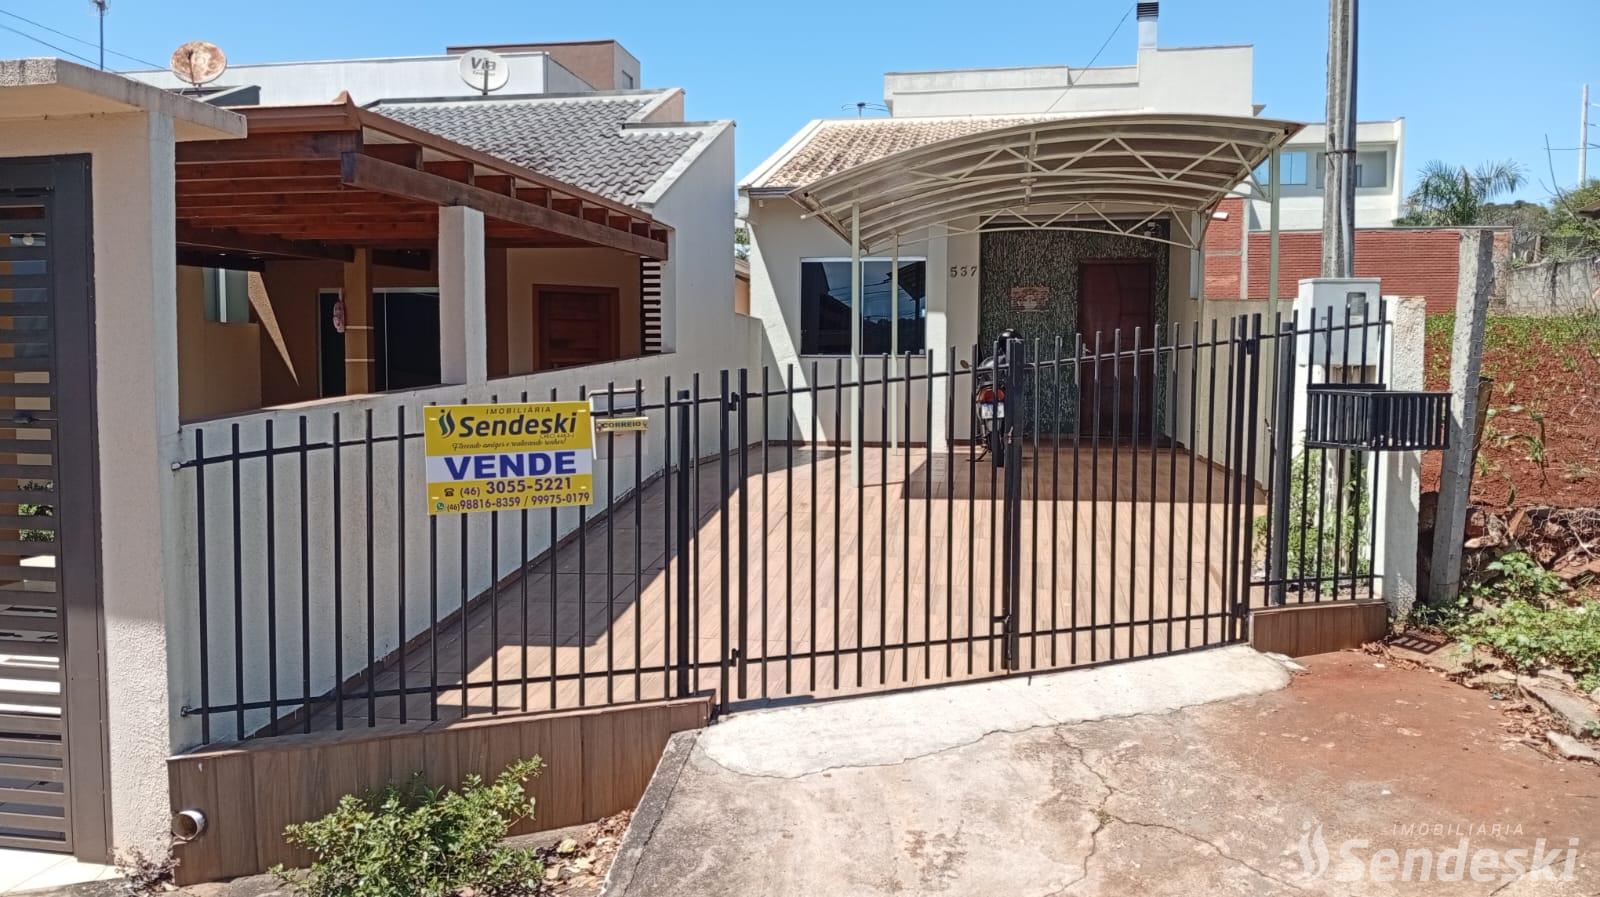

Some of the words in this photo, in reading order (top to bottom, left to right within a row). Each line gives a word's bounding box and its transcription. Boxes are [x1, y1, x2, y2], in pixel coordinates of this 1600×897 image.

[950, 266, 977, 277] 537
[459, 412, 577, 437] Sendeski
[444, 451, 577, 480] VENDE
[460, 487, 481, 497] (46)
[486, 477, 572, 495] 3055-5221
[531, 492, 590, 505] 99975-0179
